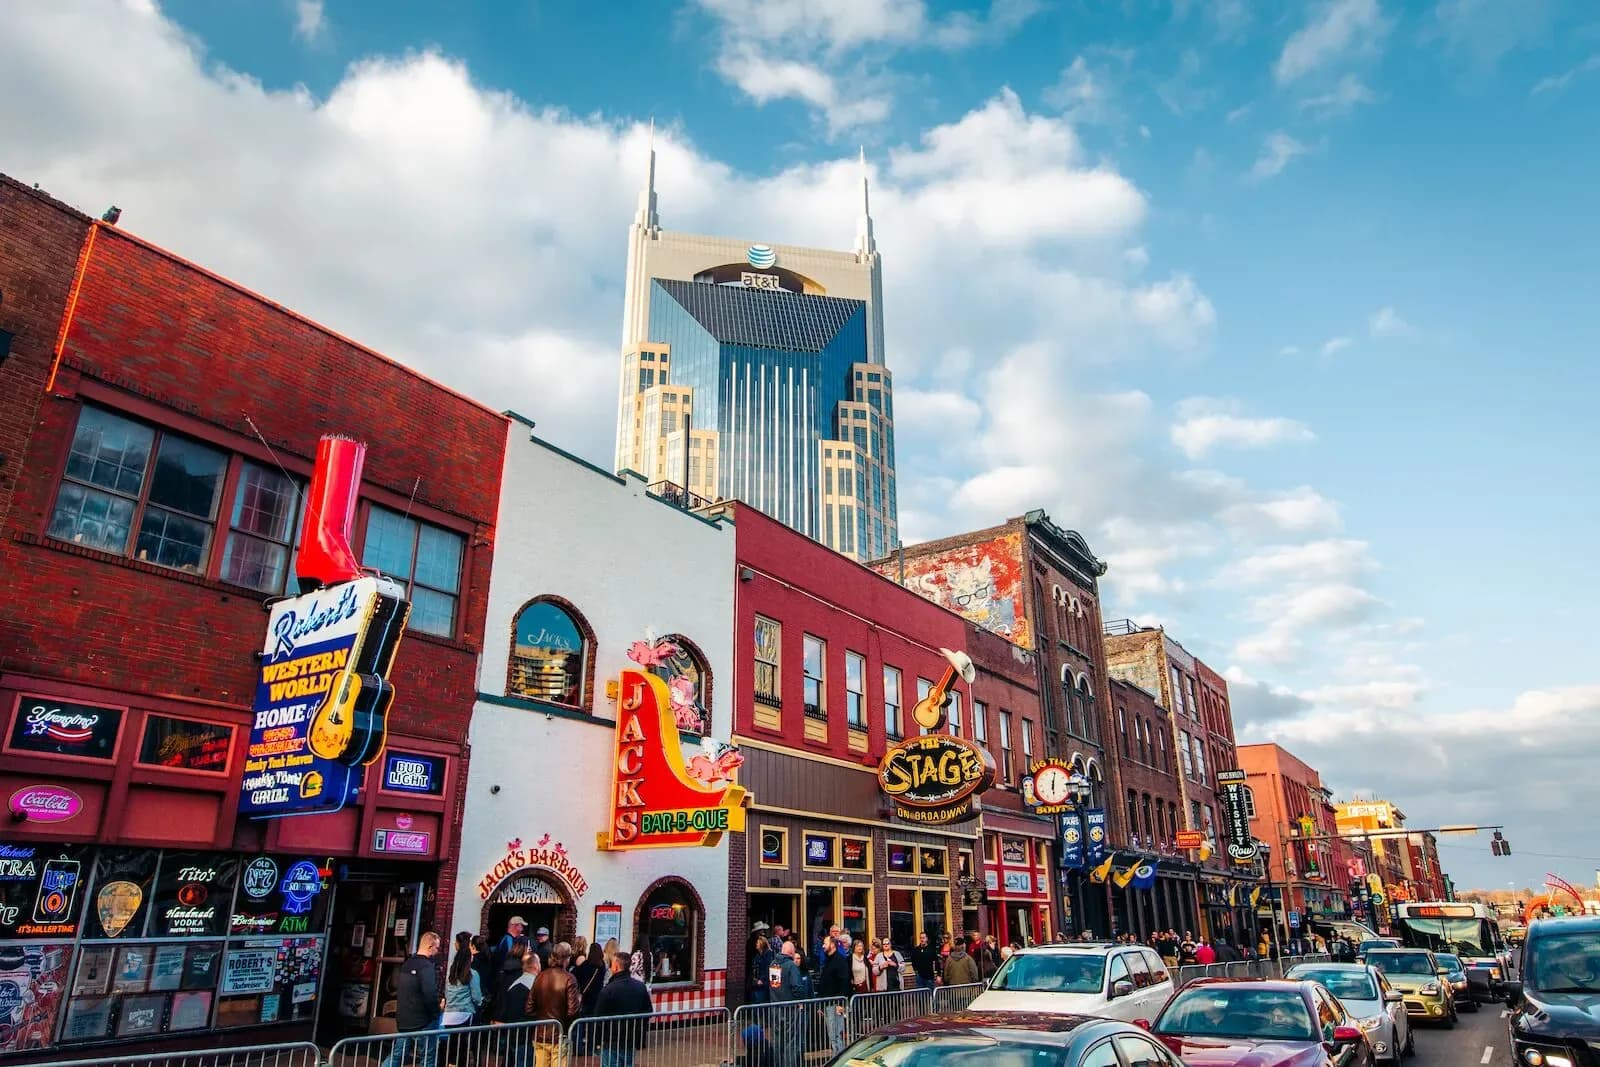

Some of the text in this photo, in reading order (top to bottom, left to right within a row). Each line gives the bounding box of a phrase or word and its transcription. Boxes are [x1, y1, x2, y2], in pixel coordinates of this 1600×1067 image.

[743, 275, 779, 289] at&t
[263, 648, 349, 684] WESTERN
[270, 673, 334, 701] WORLD
[26, 706, 99, 728] Yuengling
[254, 704, 306, 730] HOME
[396, 761, 425, 774] BUD
[615, 682, 646, 842] JACKS
[1031, 757, 1074, 773] BIG TIME
[389, 771, 428, 787] LIGHT
[885, 748, 981, 795] STAGE
[251, 787, 289, 804] GRILL
[897, 803, 968, 821] ON BROADWAY
[1226, 784, 1245, 845] WHISKEY
[642, 809, 729, 833] BAR-B-QUE
[178, 867, 216, 882] Tito's
[478, 850, 525, 900] JACK'S
[165, 907, 215, 919] Handmade
[232, 914, 277, 926] Budweiser
[651, 907, 675, 919] OPEN
[18, 925, 31, 934] IT'S
[174, 919, 204, 927] VODKA
[280, 917, 309, 932] ATM
[229, 957, 273, 970] ROBERT'S
